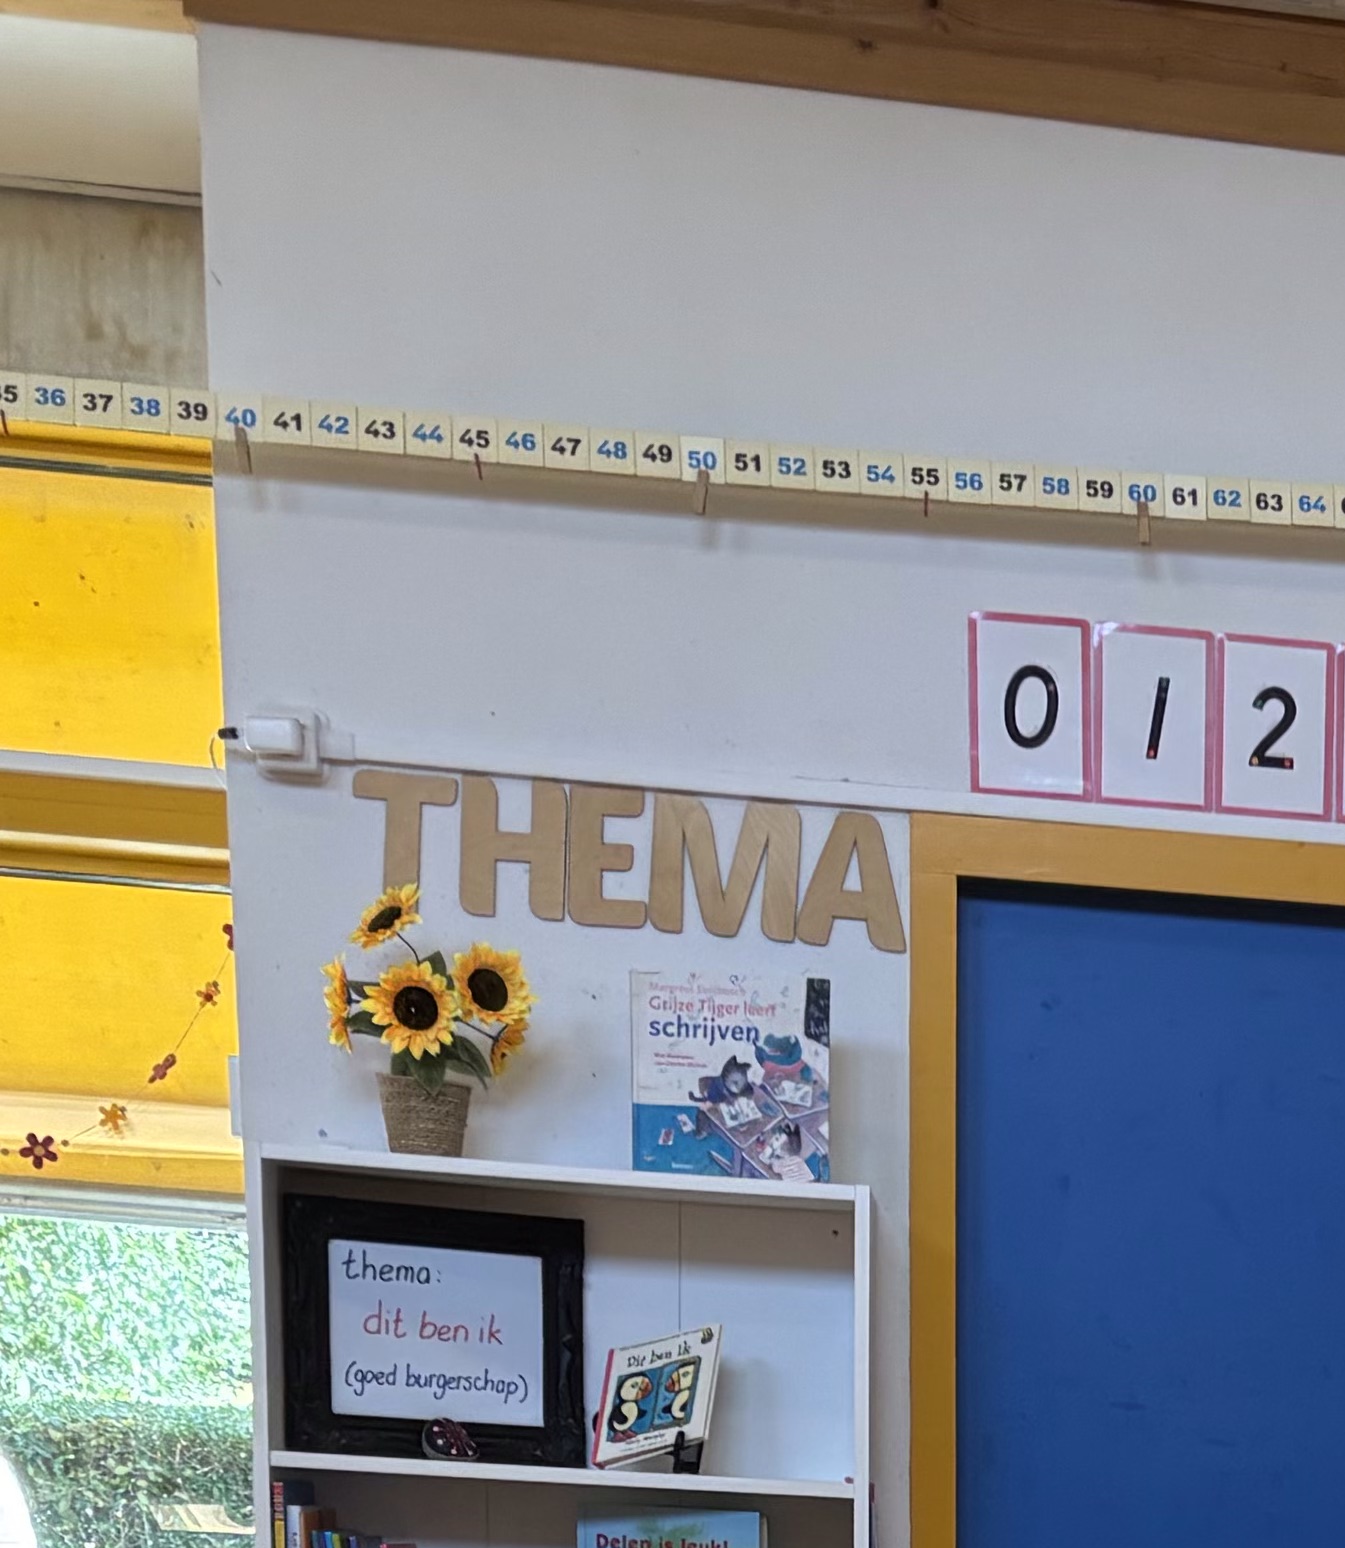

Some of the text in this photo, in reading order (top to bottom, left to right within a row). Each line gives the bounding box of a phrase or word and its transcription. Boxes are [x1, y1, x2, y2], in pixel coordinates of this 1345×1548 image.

[34, 386, 66, 407] 36
[177, 400, 208, 422] 39
[273, 411, 302, 432] 41
[364, 419, 396, 440] 43
[550, 436, 582, 457] 47
[688, 450, 717, 471] 50
[822, 459, 852, 479] 53
[911, 466, 940, 486] 55
[1085, 479, 1114, 499] 59
[1172, 487, 1198, 507] 61
[1003, 664, 1058, 749] 0
[1145, 675, 1170, 760] 1
[1247, 685, 1298, 771] 2
[352, 768, 906, 953] THEMA
[648, 1014, 760, 1047] schrijven
[342, 1249, 443, 1286] thema:
[363, 1301, 504, 1346] dit ben ik
[344, 1361, 530, 1405] (goed burgerschap)
